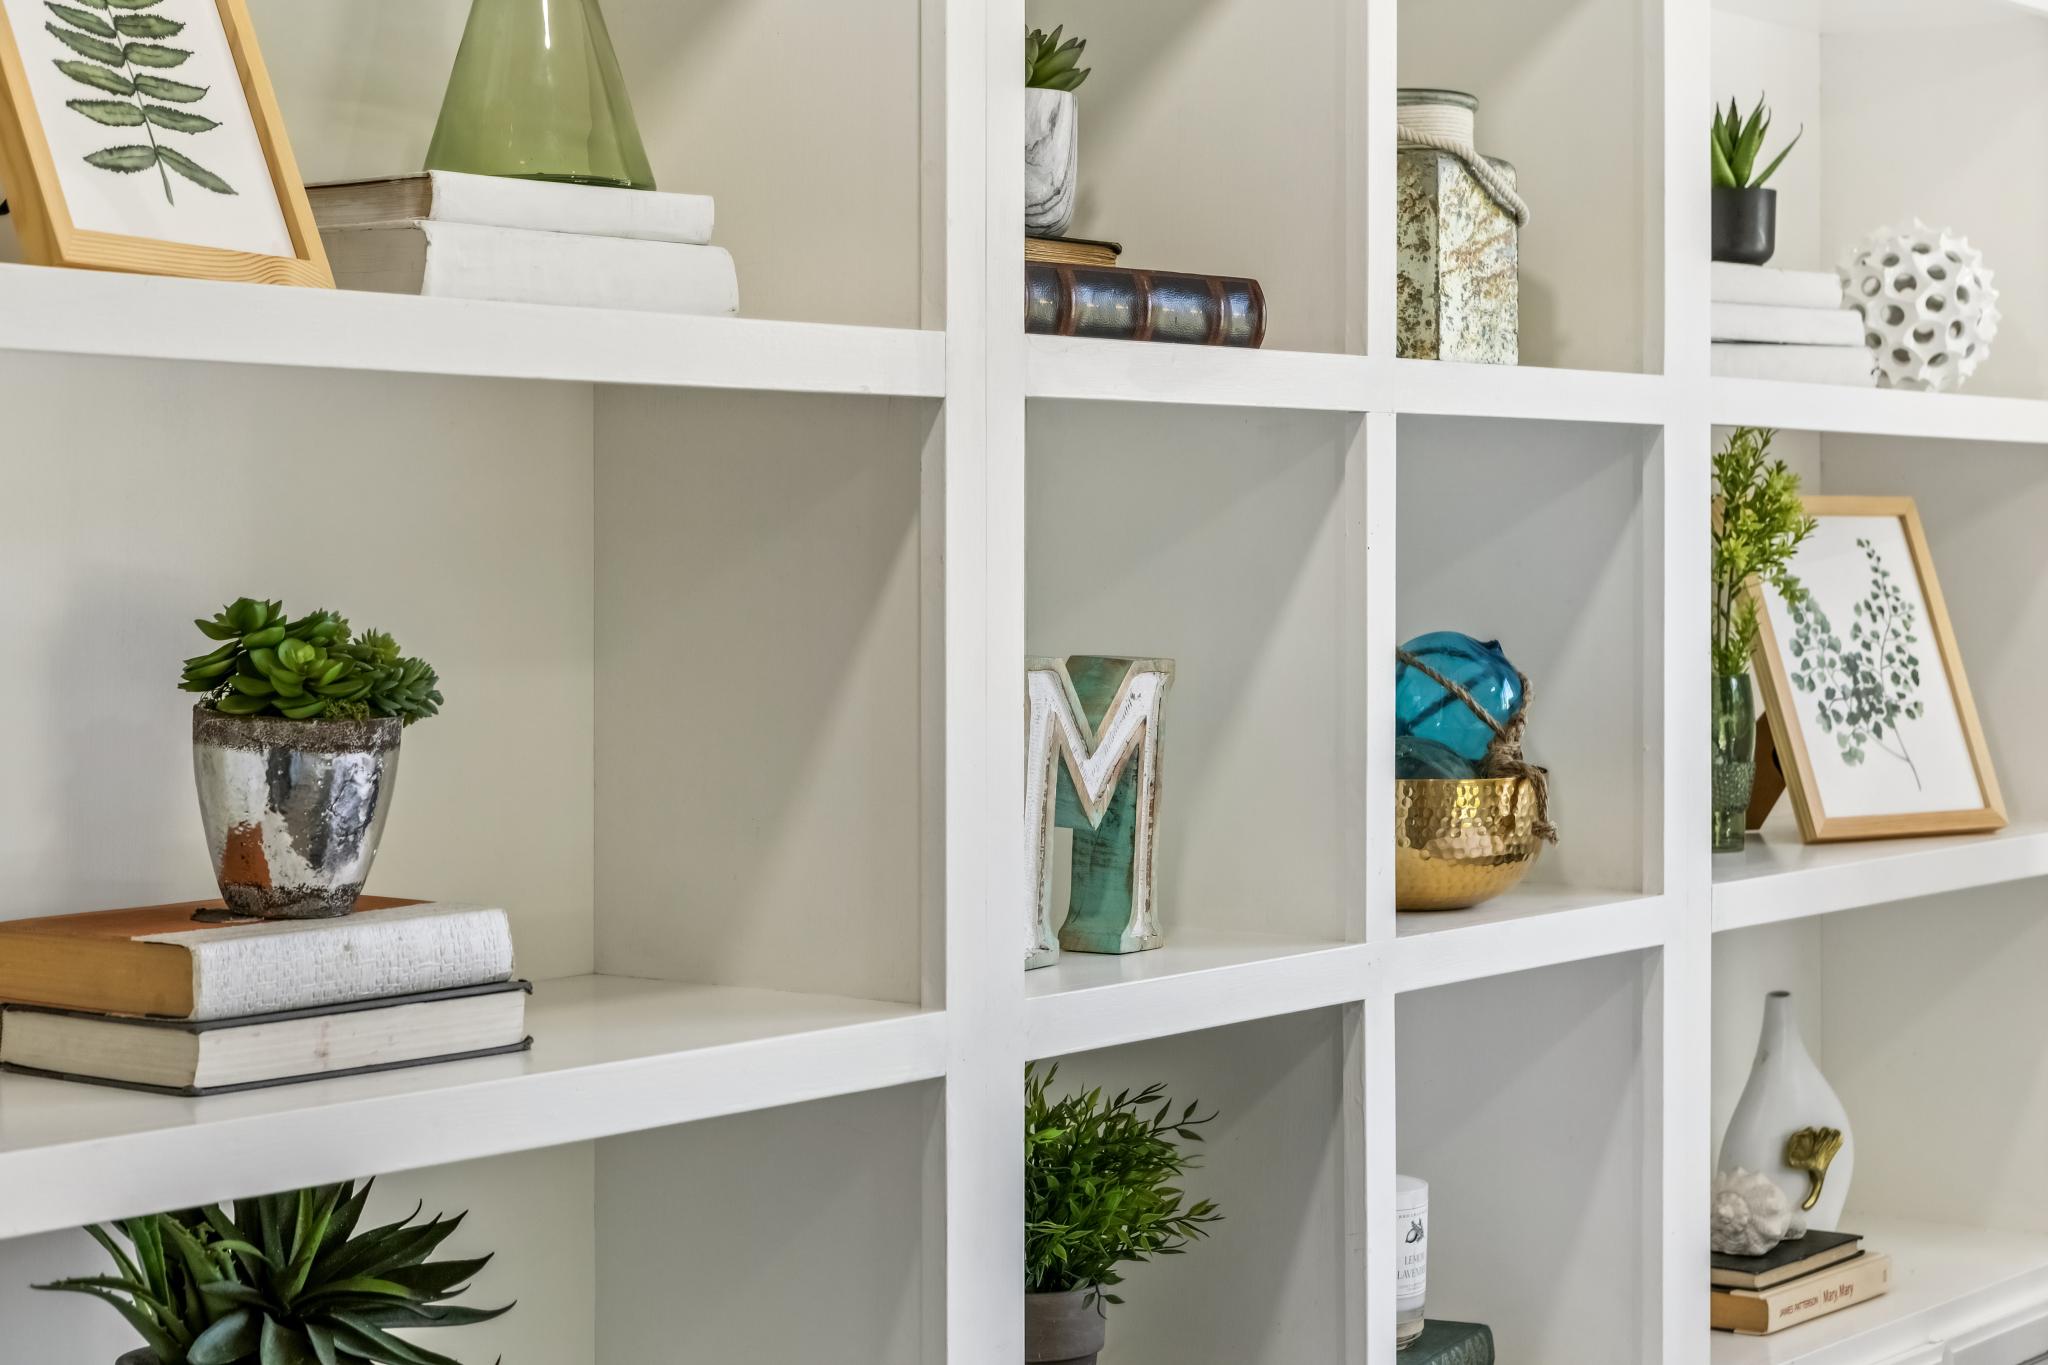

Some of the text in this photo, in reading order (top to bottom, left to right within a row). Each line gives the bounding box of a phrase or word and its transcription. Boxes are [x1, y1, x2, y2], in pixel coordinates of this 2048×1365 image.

[1024, 655, 1175, 969] M
[1404, 1252, 1425, 1265] LEM
[1839, 1283, 1854, 1297] Mary
